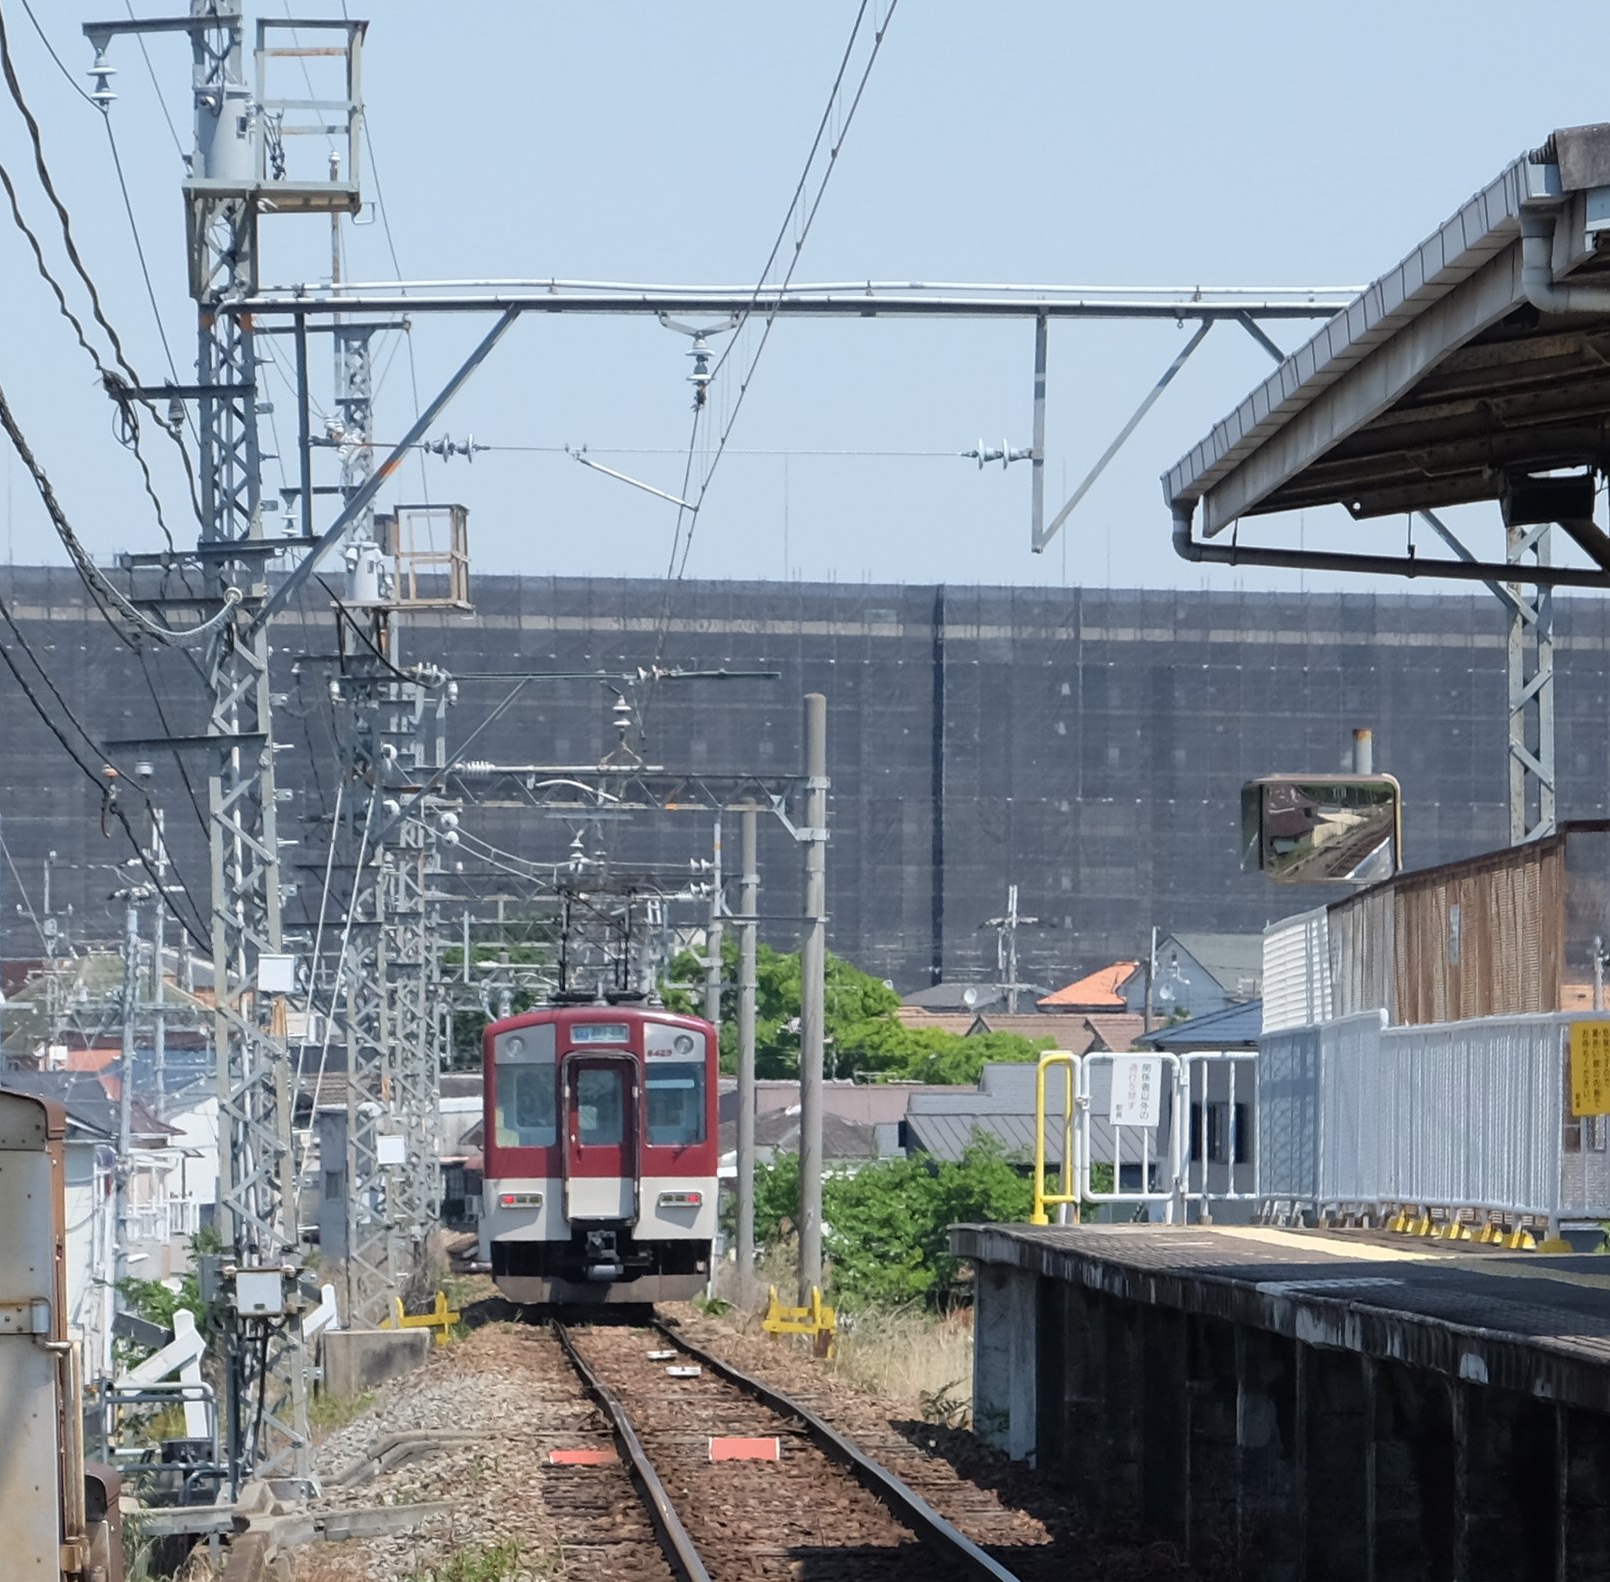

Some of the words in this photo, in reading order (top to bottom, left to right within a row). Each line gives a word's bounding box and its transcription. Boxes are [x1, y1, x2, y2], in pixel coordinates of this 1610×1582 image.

[1140, 1063, 1152, 1120] 関係者以外の
